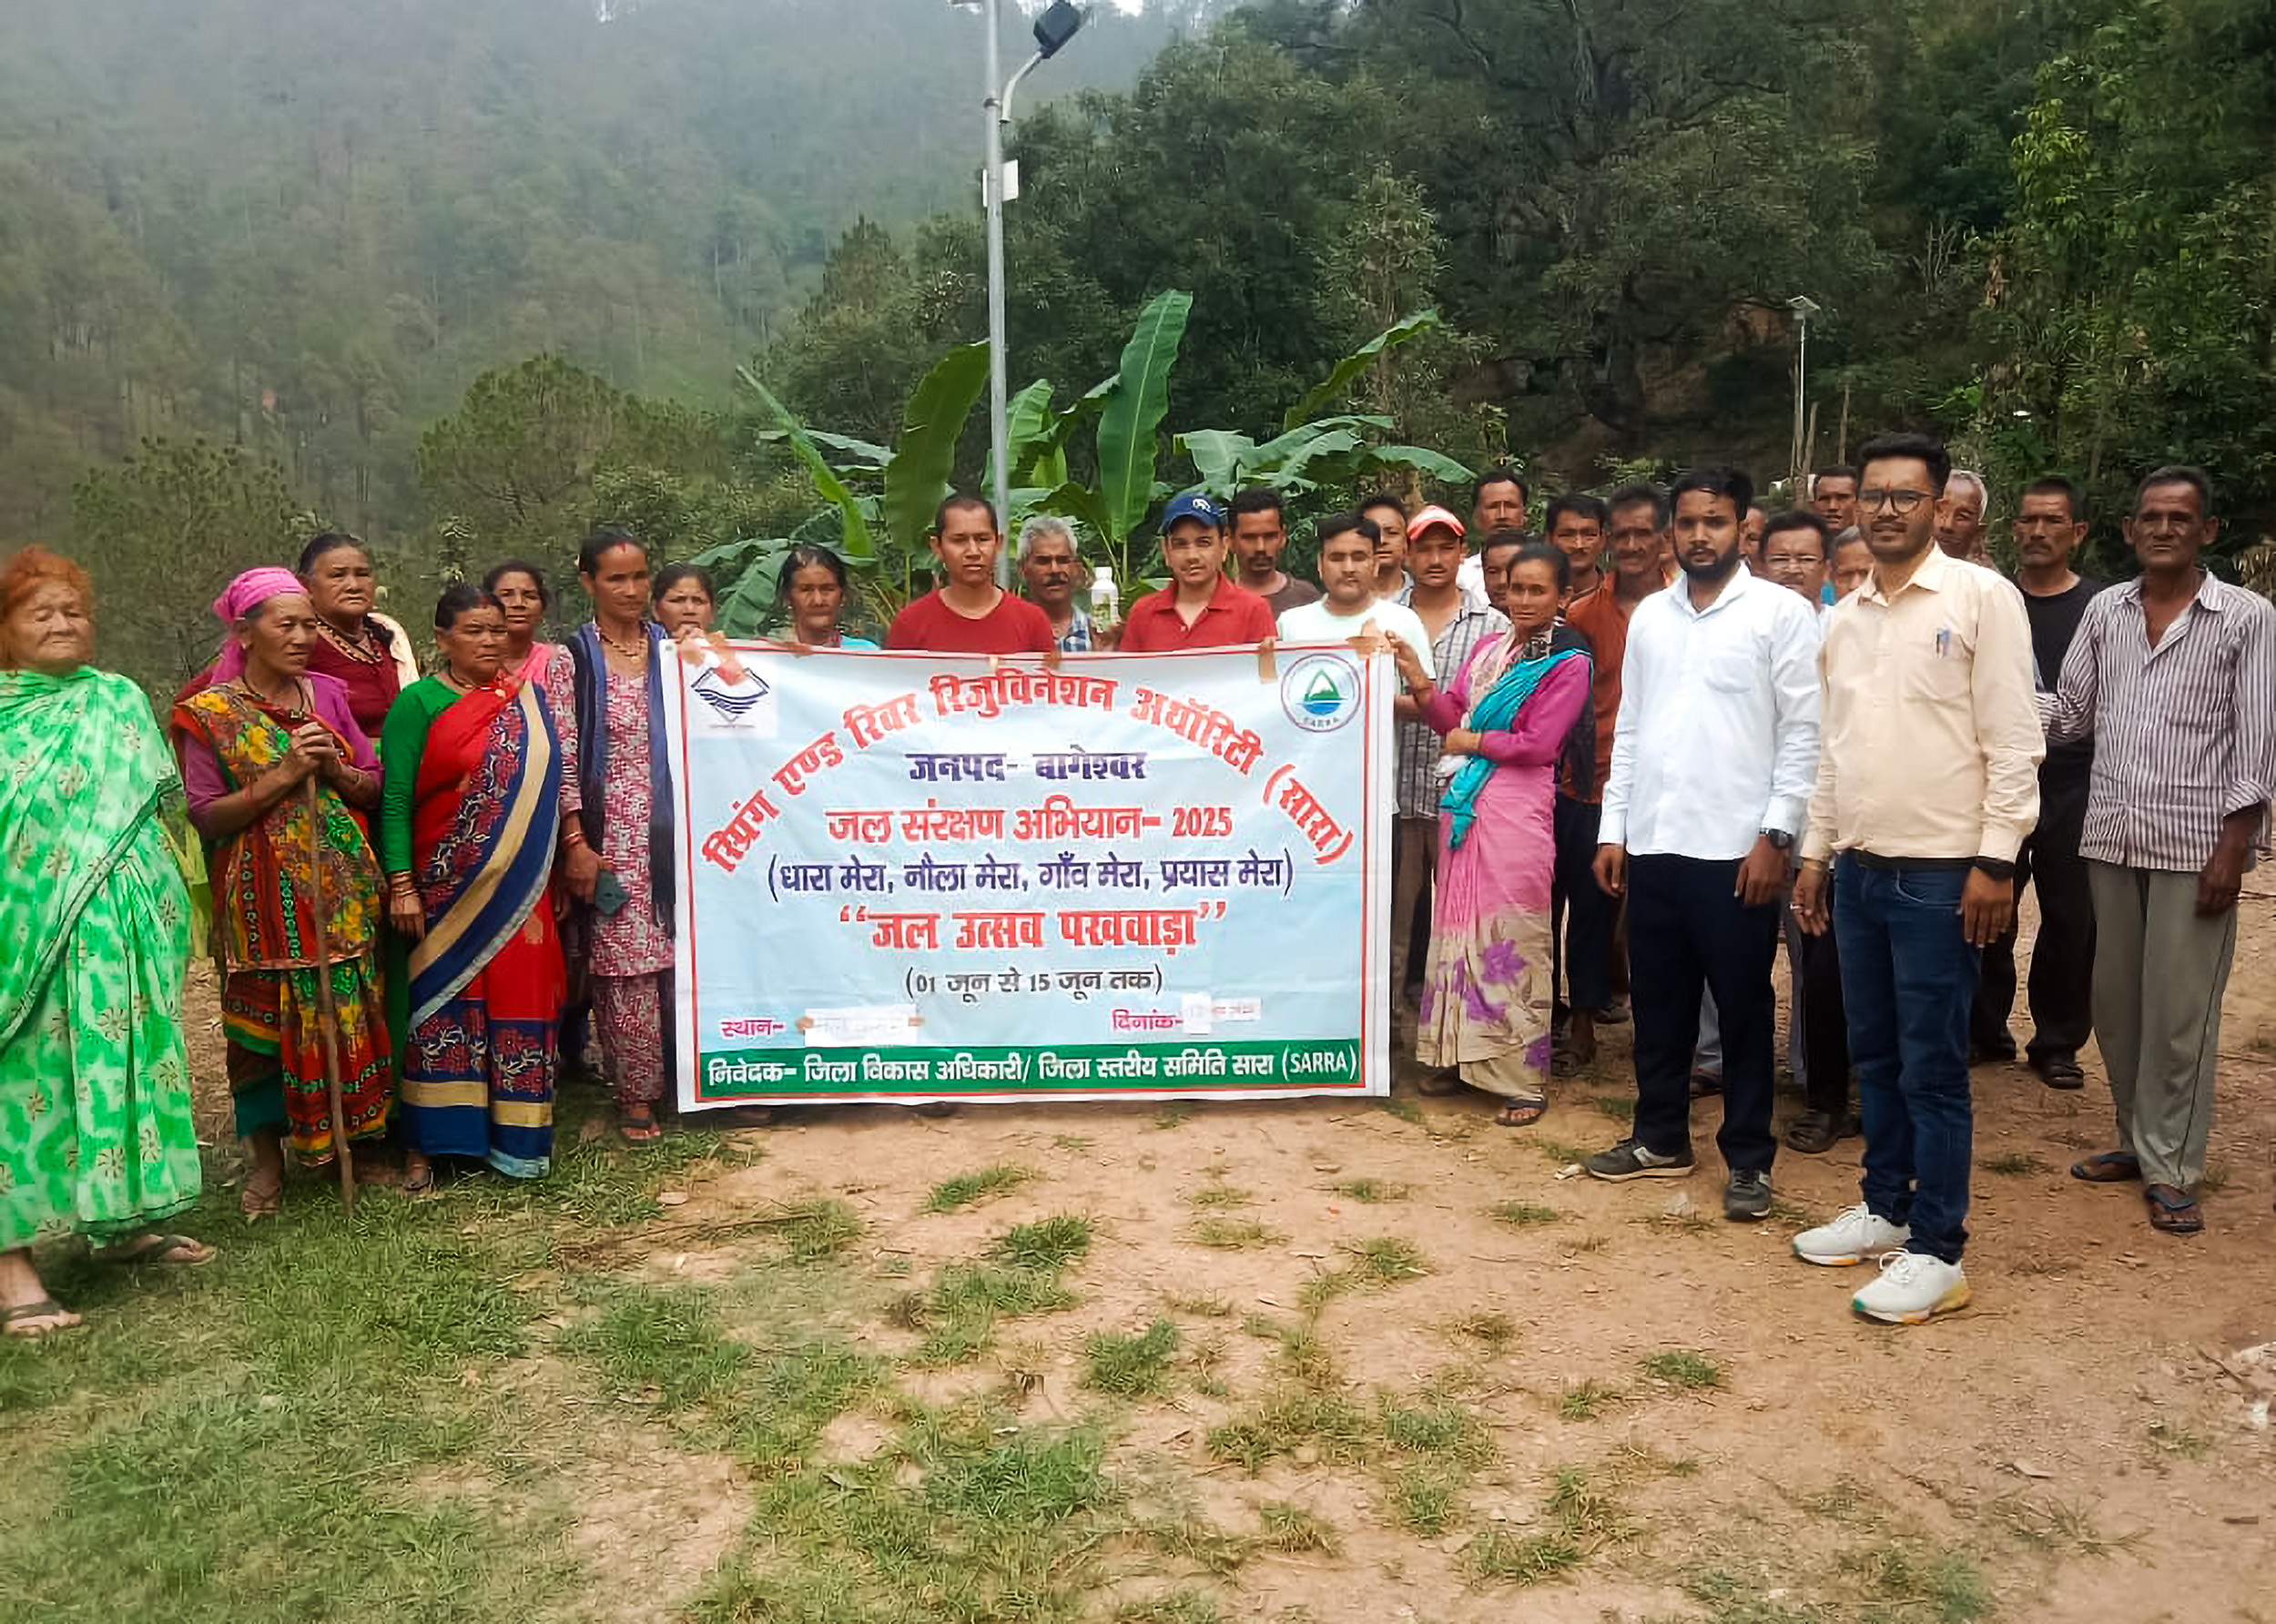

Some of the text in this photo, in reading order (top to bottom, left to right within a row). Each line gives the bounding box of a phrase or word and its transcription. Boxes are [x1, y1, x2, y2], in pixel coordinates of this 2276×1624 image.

[772, 732, 844, 796] एण्ड
[843, 694, 922, 748] रिवर
[930, 667, 1119, 718] रिजुविनेशन
[1263, 764, 1353, 864] (सारा)
[905, 744, 1148, 782] जनपद- बागेश्वर
[825, 795, 1233, 843] जल संरक्षण अभियान- 2025
[767, 848, 1294, 902] (धारा मेरा, नौला मेरा, गाँव मेरा, प्रयास मेरा)
[951, 909, 1044, 949] उत्सव
[906, 963, 1163, 1003] (01 जून से 15 जून तक)
[720, 1017, 787, 1038] स्थान-
[1113, 1009, 1184, 1030] दिनांक-
[707, 1043, 1358, 1085] निवेदक- जिला विकास अधिकारी/ जिला स्तरीय समिति सारा (SARRA)
